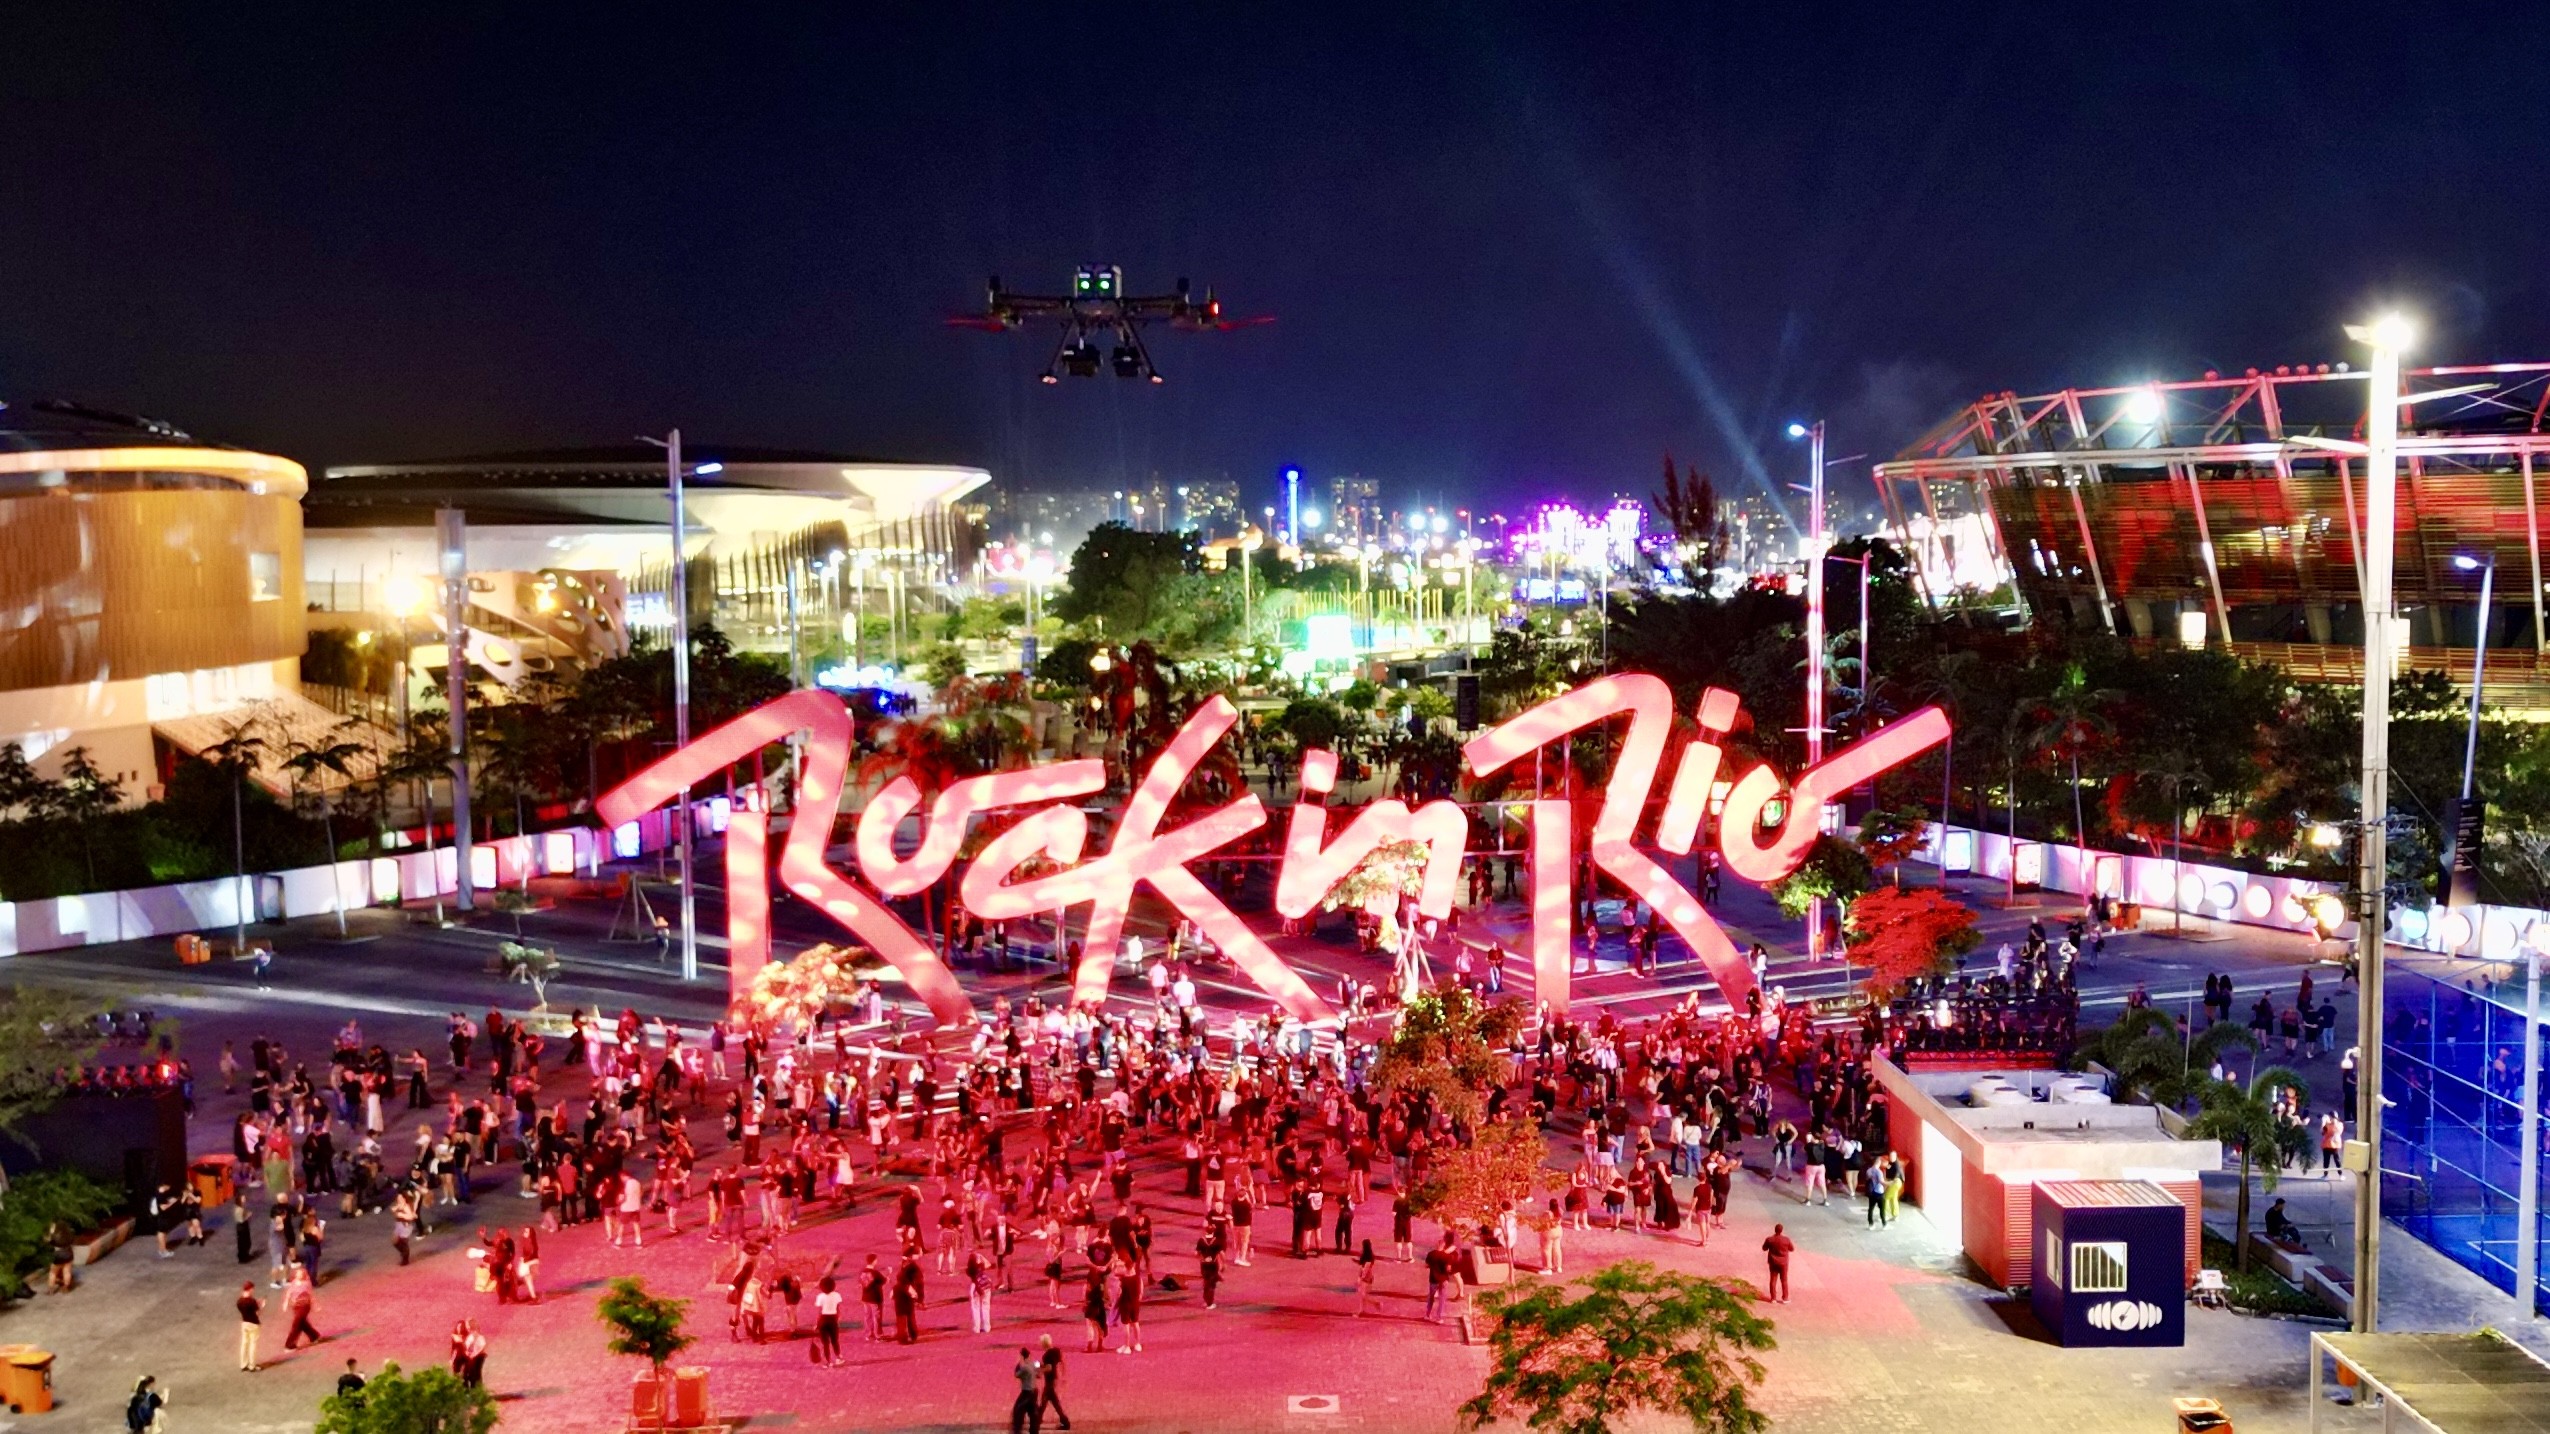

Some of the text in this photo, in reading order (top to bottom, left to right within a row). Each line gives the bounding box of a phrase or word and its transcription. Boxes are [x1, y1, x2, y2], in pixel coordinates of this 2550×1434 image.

[595, 672, 1953, 1028] Rock in Rio
